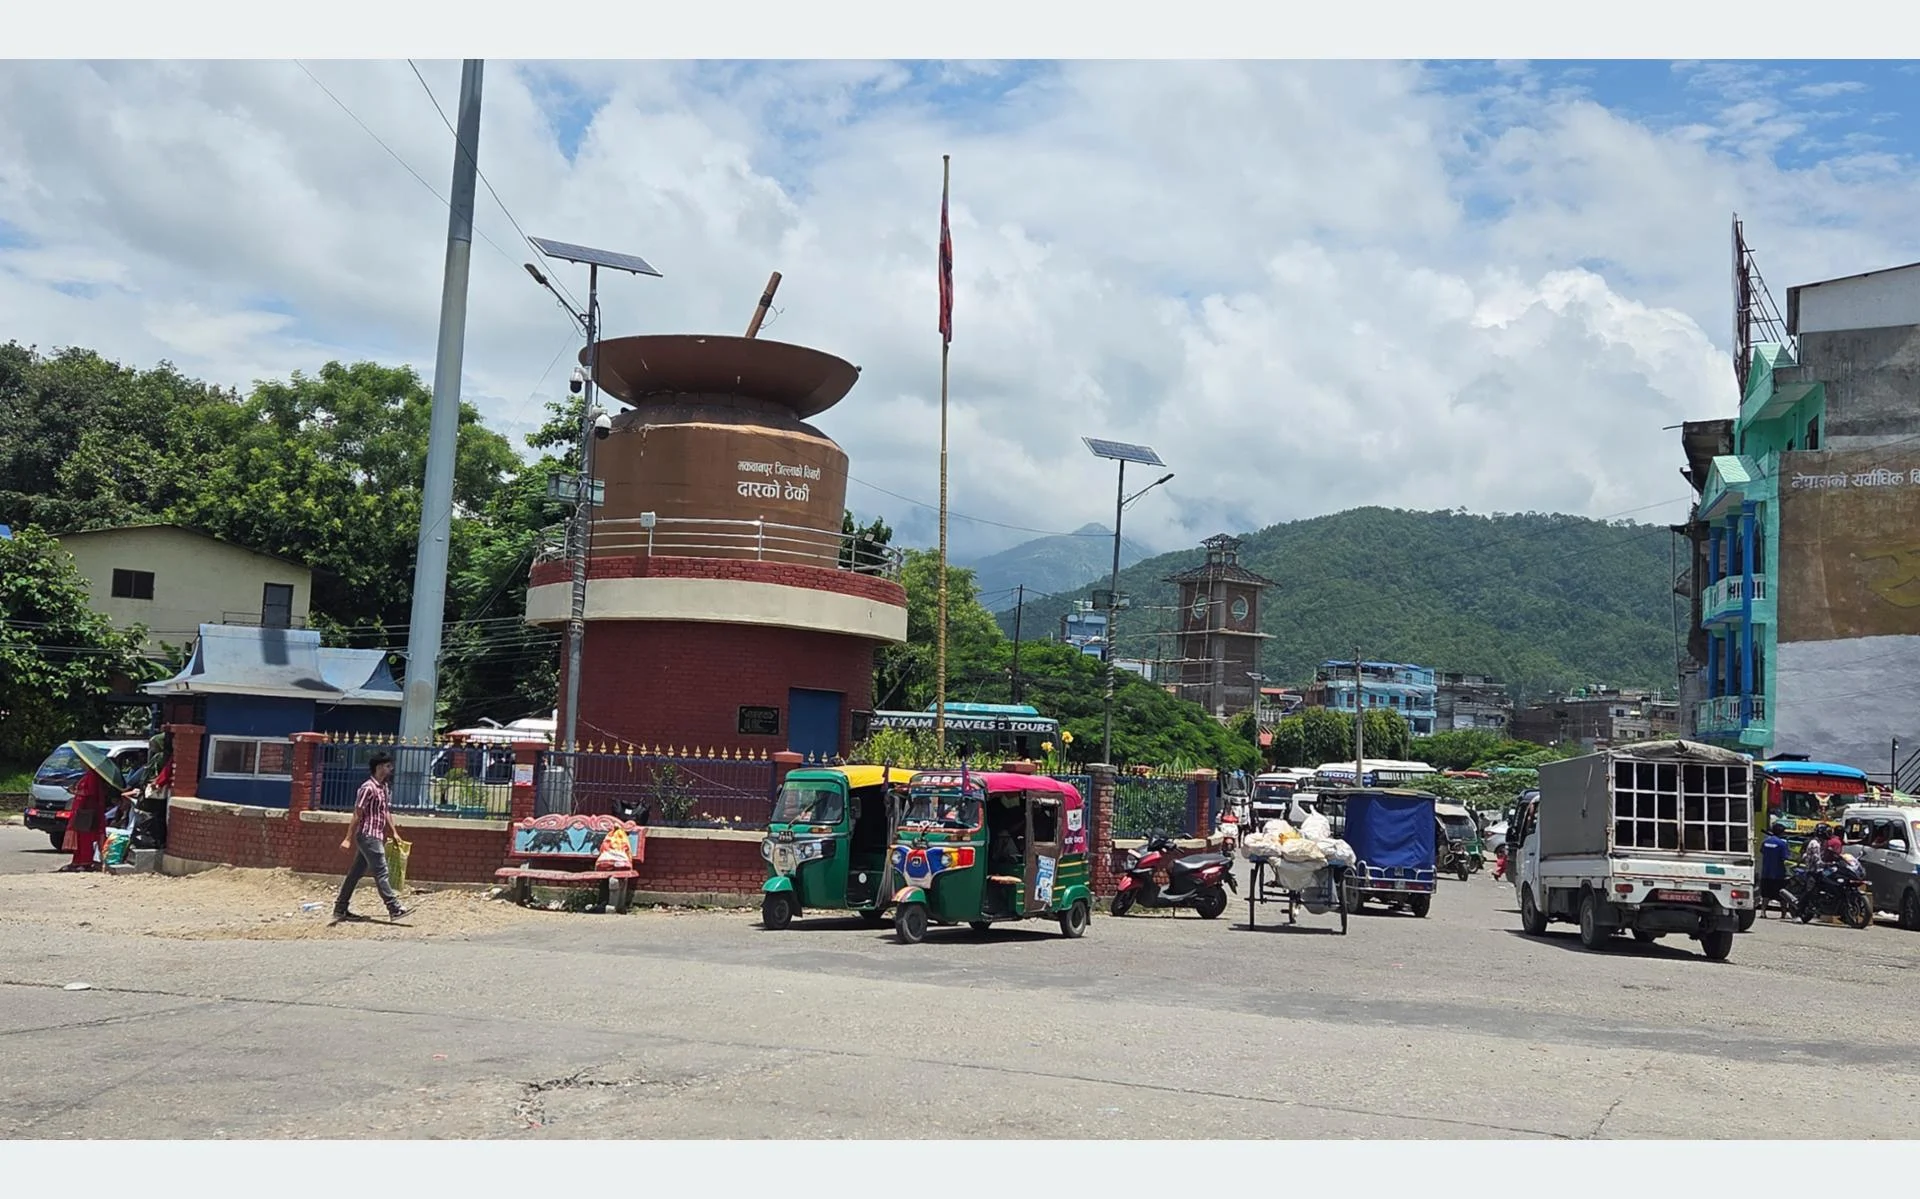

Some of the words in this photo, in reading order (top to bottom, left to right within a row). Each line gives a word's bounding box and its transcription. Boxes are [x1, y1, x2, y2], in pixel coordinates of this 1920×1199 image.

[737, 480, 780, 498] दारको
[784, 480, 810, 502] ठेकी
[870, 717, 933, 728] SATYAM
[944, 719, 996, 730] RAVELS
[1010, 722, 1053, 732] TOURS
